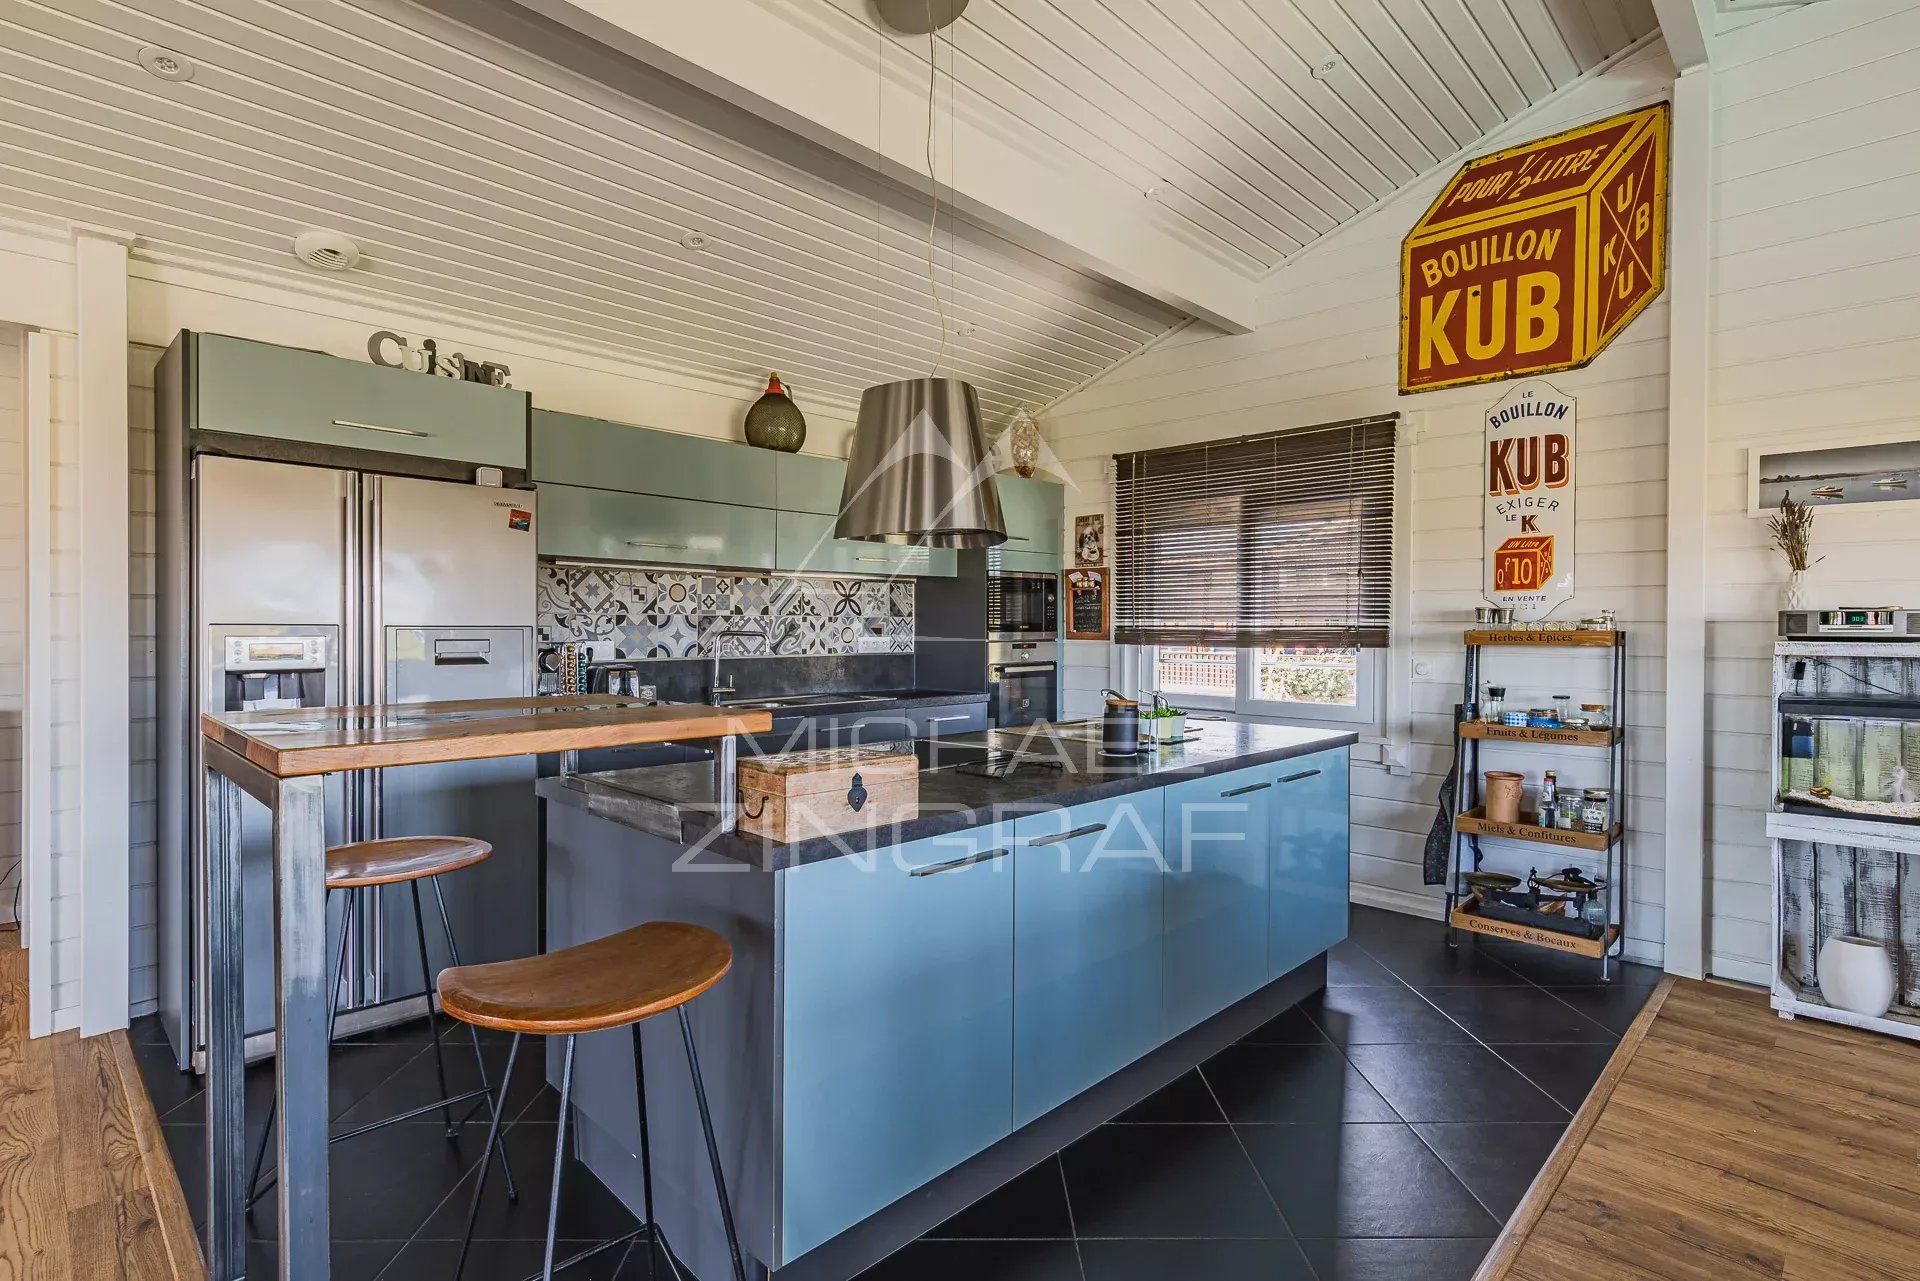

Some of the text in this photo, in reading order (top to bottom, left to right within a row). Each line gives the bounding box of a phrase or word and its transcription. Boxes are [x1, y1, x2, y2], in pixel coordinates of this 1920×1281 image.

[1447, 170, 1513, 207] POUR
[1531, 144, 1608, 185] LITRE
[1420, 229, 1562, 288] BOUILLON
[1418, 270, 1561, 370] KUB
[1489, 401, 1570, 429] BOUILLON
[1489, 433, 1570, 496] KUB
[1496, 497, 1559, 515] EXIGER
[1521, 514, 1541, 534] K
[1489, 633, 1524, 642] Herbes
[1526, 633, 1535, 642] &
[1486, 727, 1579, 742] Fruits & Légumes
[1477, 822, 1505, 833] Miels
[1507, 826, 1516, 835] &
[1519, 827, 1577, 843] Confitures
[1469, 919, 1577, 949] Conserves & Bocaux
